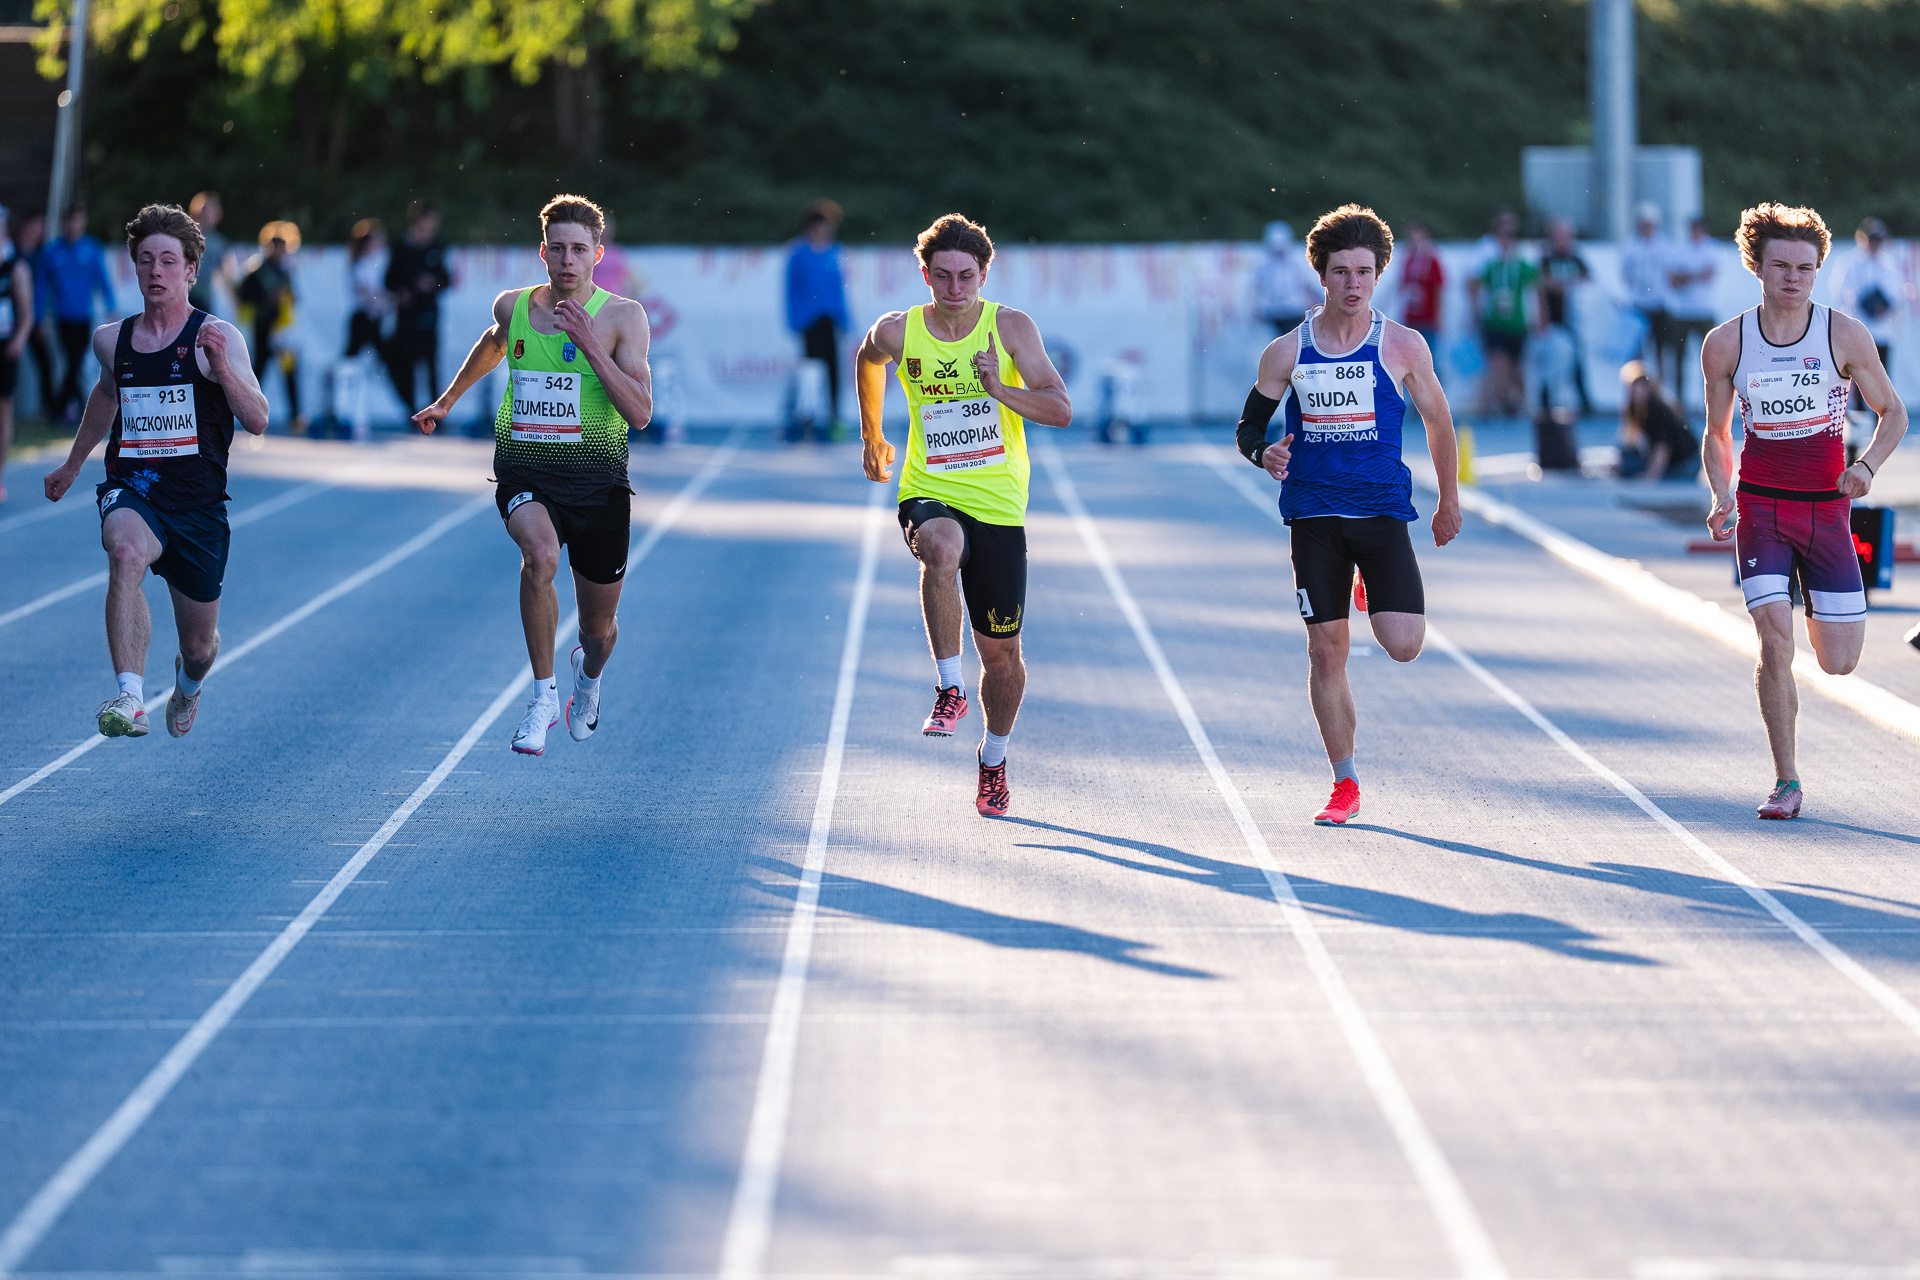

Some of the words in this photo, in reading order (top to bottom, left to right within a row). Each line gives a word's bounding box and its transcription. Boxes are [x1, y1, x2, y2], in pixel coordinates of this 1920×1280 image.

[1336, 366, 1365, 379] 868
[1791, 373, 1820, 387] 765
[544, 376, 573, 390] 542
[920, 384, 954, 395] MKL
[159, 389, 186, 404] 913
[1308, 391, 1358, 407] SIUDA
[514, 399, 576, 418] SZUMEŁDA
[961, 400, 991, 418] 386
[1761, 395, 1816, 415] ROSÓŁ
[124, 414, 193, 435] MĄCZKOWIAK
[926, 424, 999, 448] PROKOPIAK
[1304, 432, 1322, 443] AZS
[1325, 428, 1378, 442] POZNAŃ
[512, 494, 527, 507] 4
[1297, 592, 1308, 615] 2
